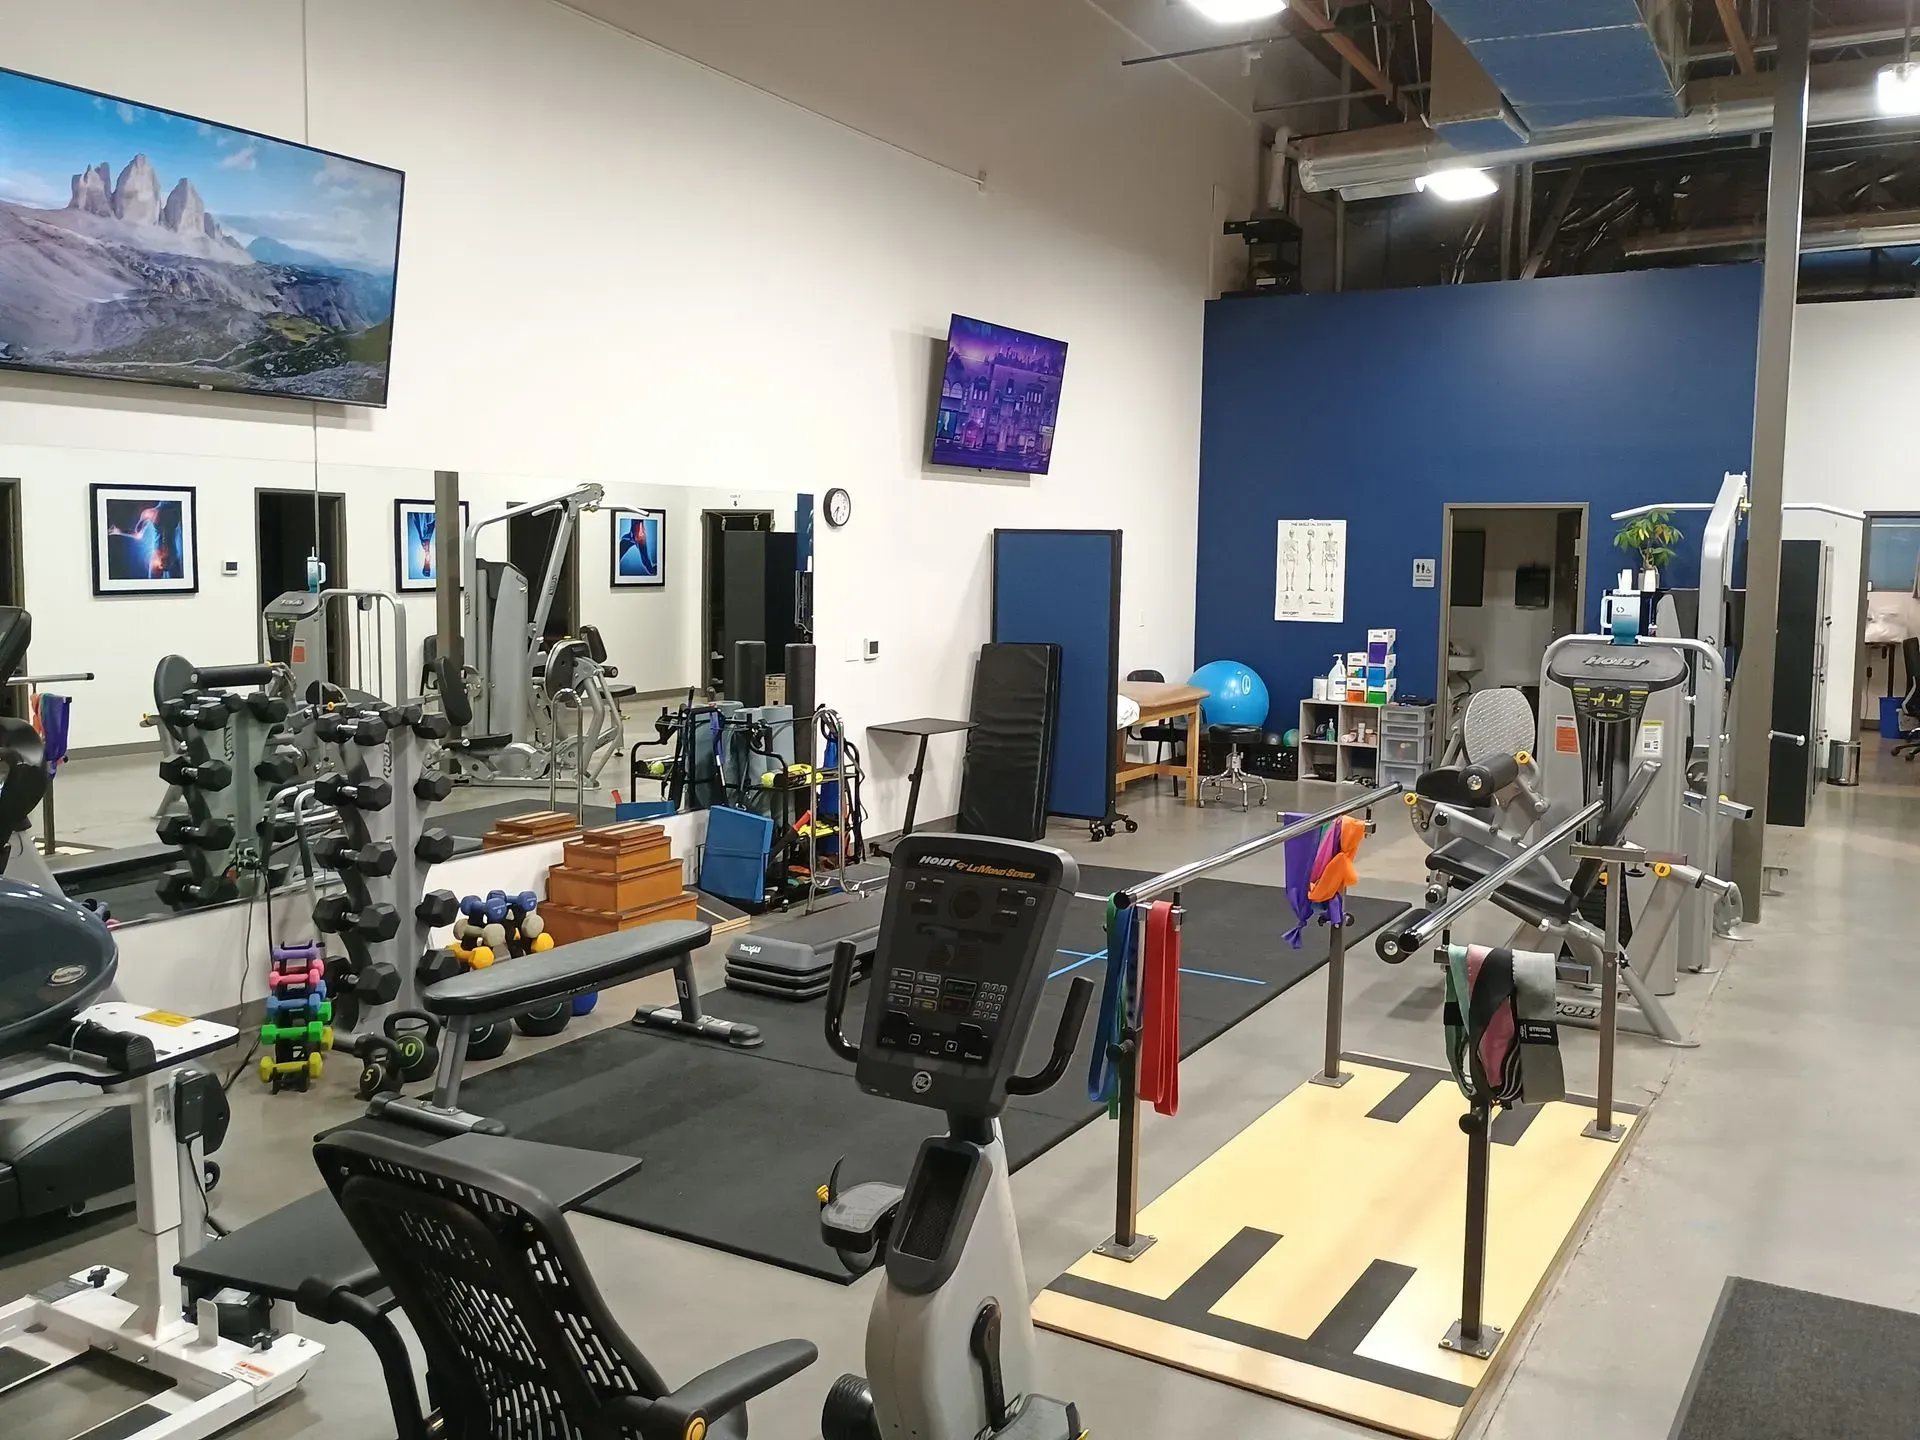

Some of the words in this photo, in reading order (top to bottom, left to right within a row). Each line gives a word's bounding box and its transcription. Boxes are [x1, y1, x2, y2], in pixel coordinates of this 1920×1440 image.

[1583, 655, 1648, 668] HOIST
[919, 855, 959, 867] HOIST
[363, 1068, 375, 1082] 5
